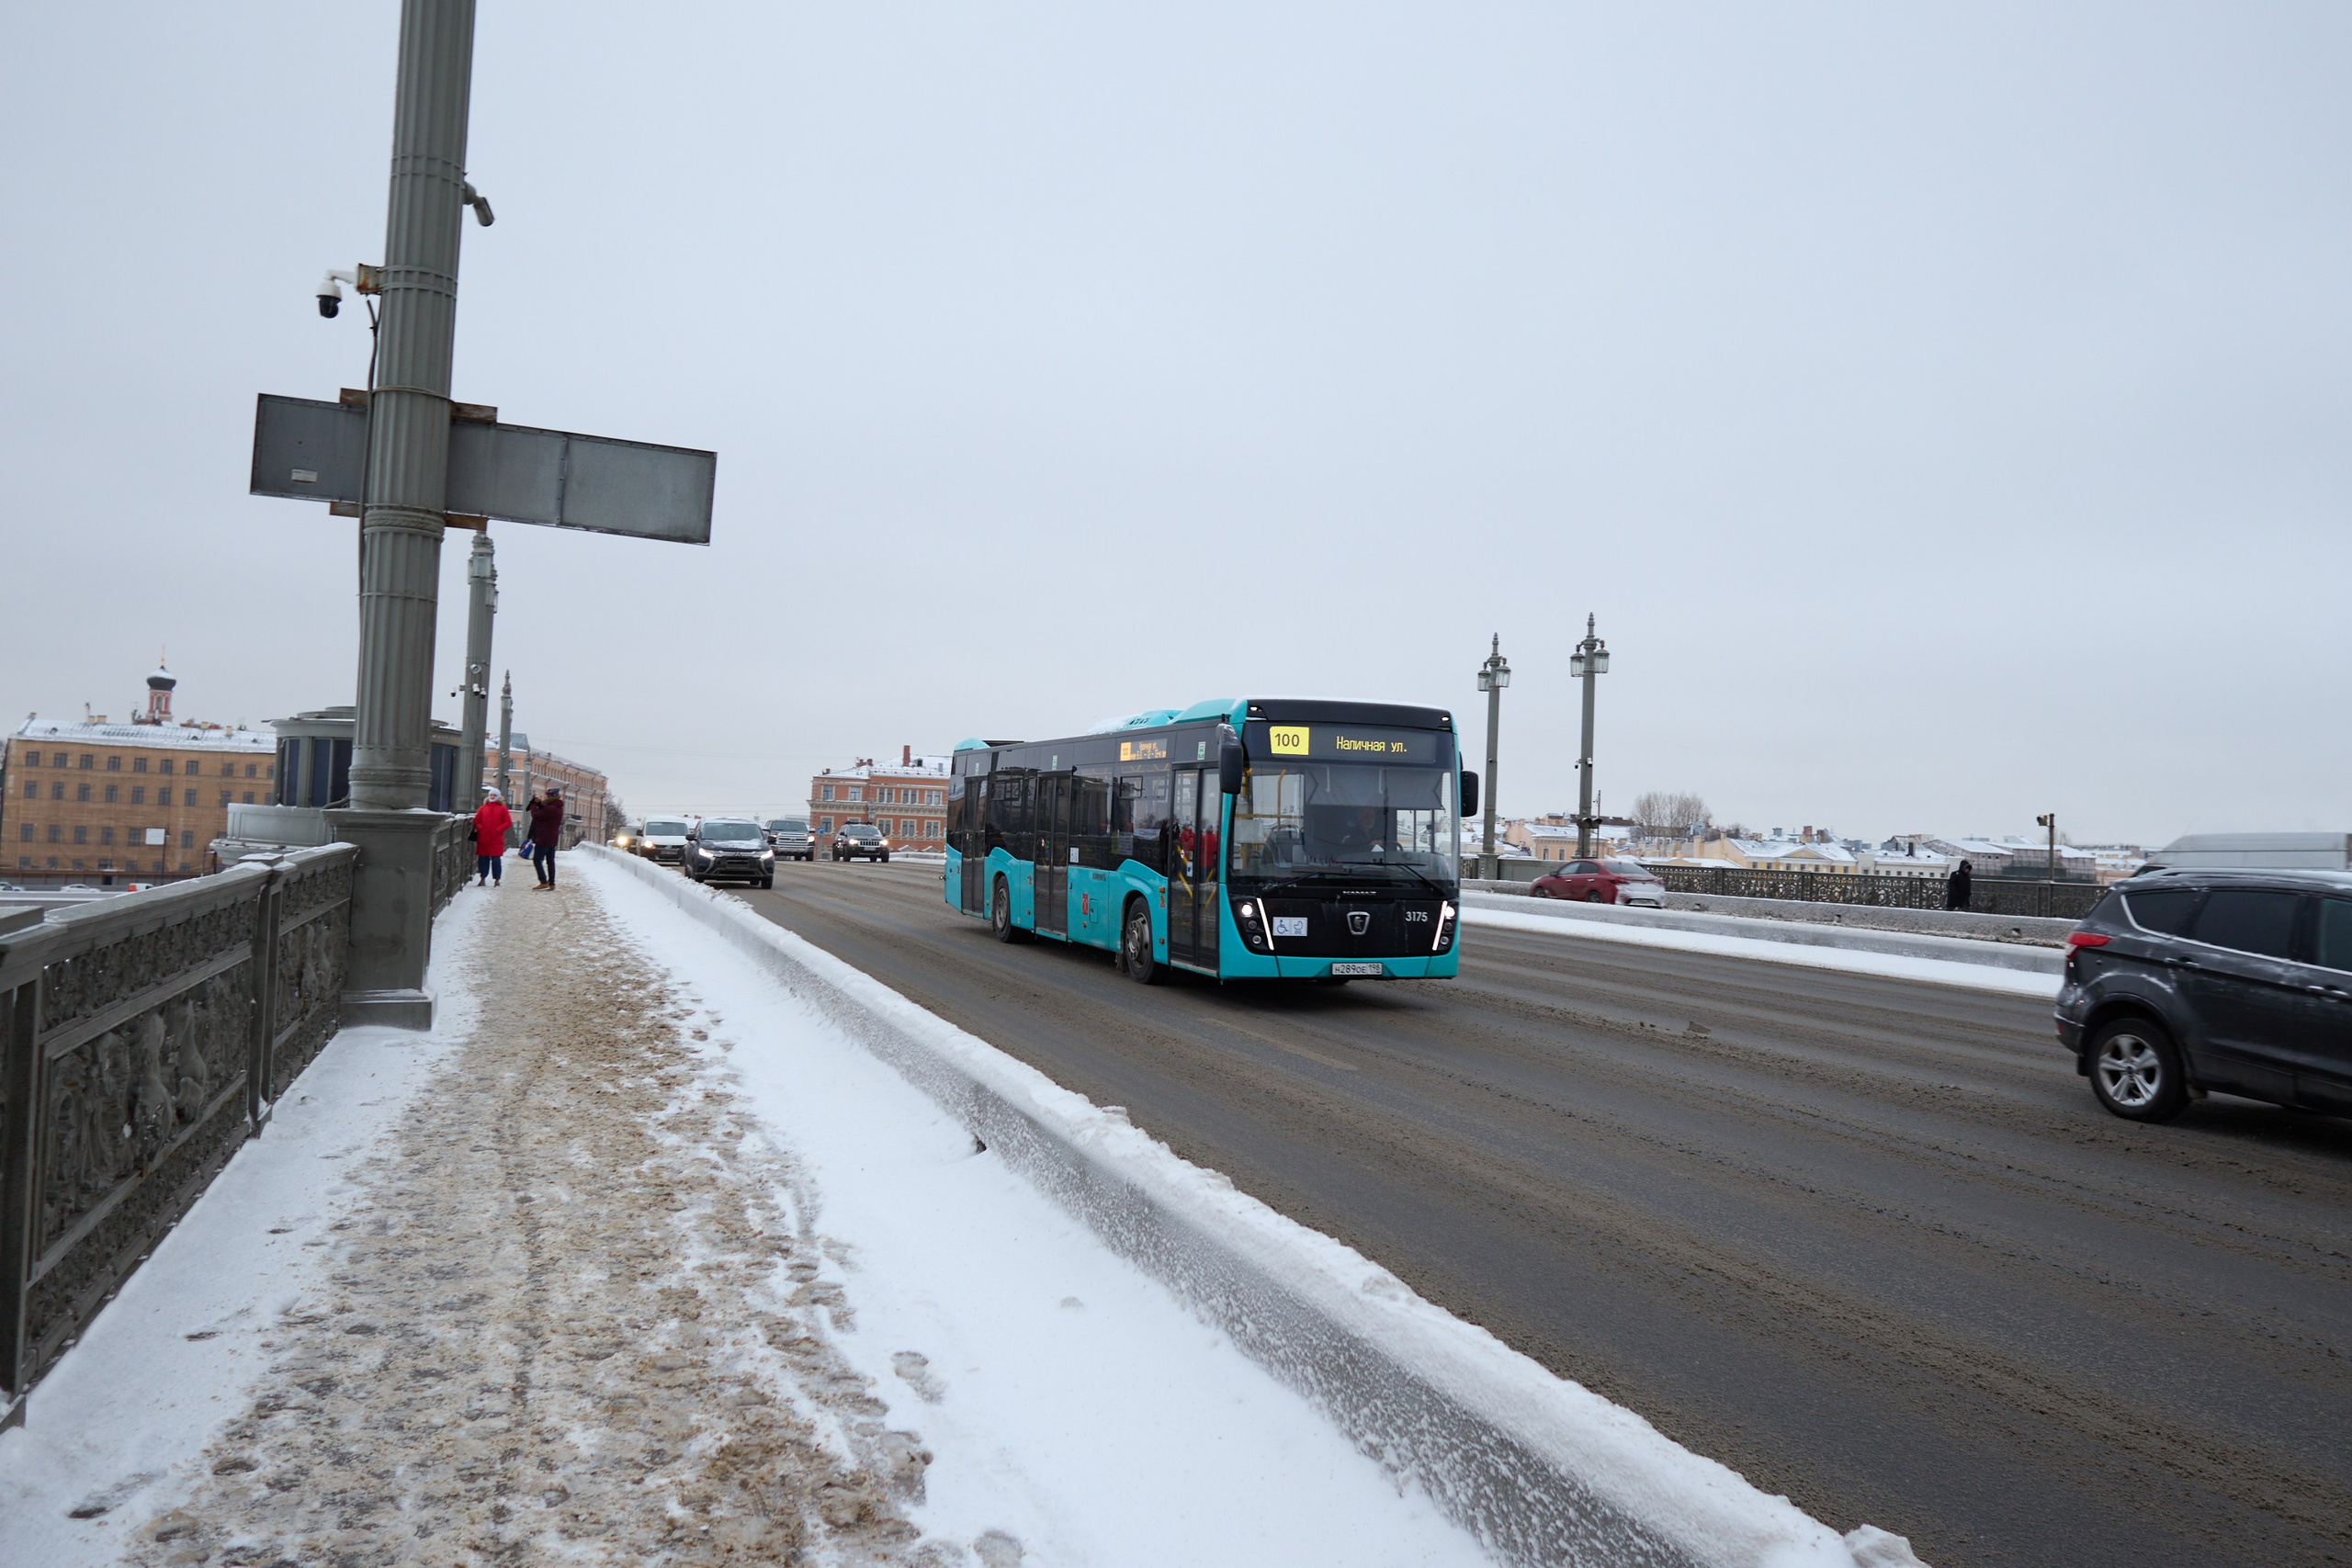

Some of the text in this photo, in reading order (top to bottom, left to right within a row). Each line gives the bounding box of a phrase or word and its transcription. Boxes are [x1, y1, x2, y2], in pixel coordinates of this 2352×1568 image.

[1274, 733, 1300, 748] 100
[1336, 735, 1408, 752] Наличная ул.
[1405, 910, 1428, 922] 3175
